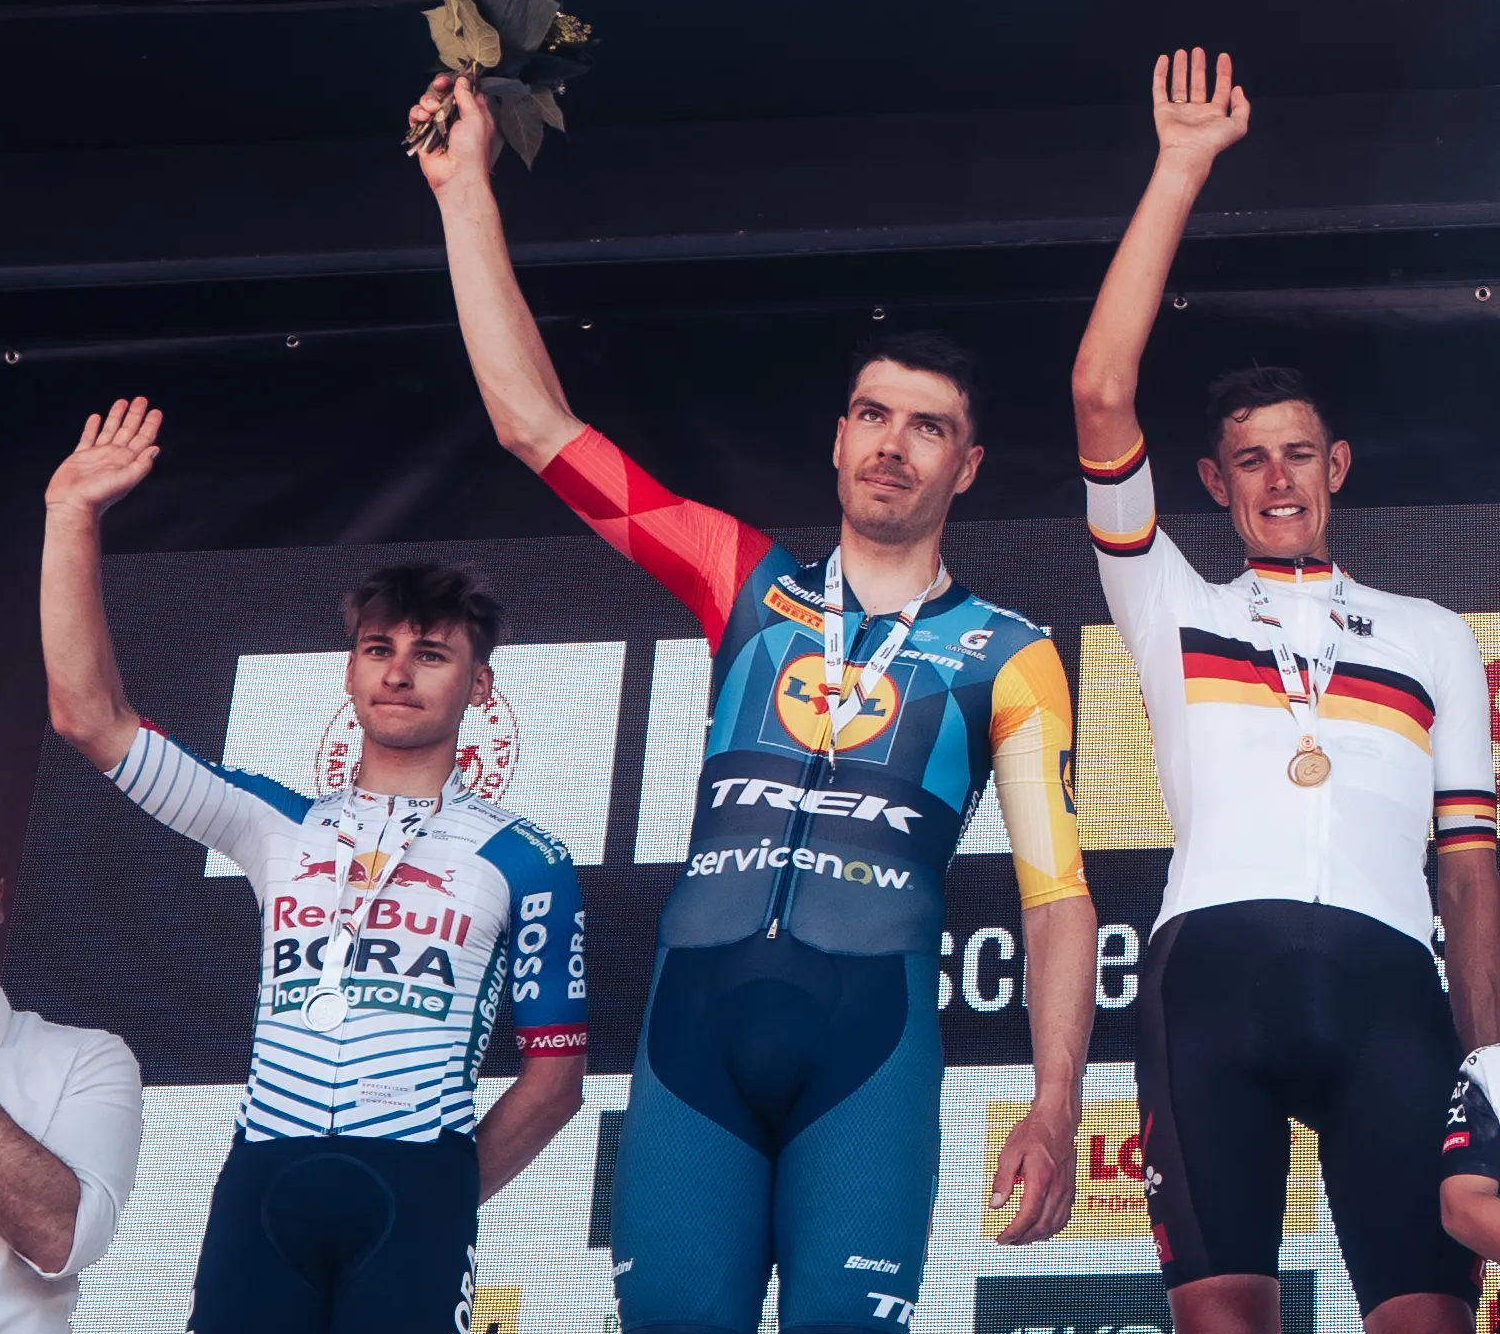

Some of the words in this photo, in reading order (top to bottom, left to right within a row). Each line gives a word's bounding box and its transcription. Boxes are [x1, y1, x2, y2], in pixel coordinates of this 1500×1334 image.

[777, 573, 826, 608] Santin
[770, 592, 823, 630] PIRELLI
[945, 644, 987, 662] GATORADE
[711, 777, 924, 835] TREK
[512, 824, 556, 865] hansgrohe
[686, 838, 911, 891] servicenow
[273, 936, 456, 988] BORA
[512, 891, 552, 1003] BOSS
[567, 910, 586, 1000] BORA
[275, 982, 446, 1013] hagrohe
[530, 1031, 587, 1049] mewa
[844, 1255, 901, 1276] Santini
